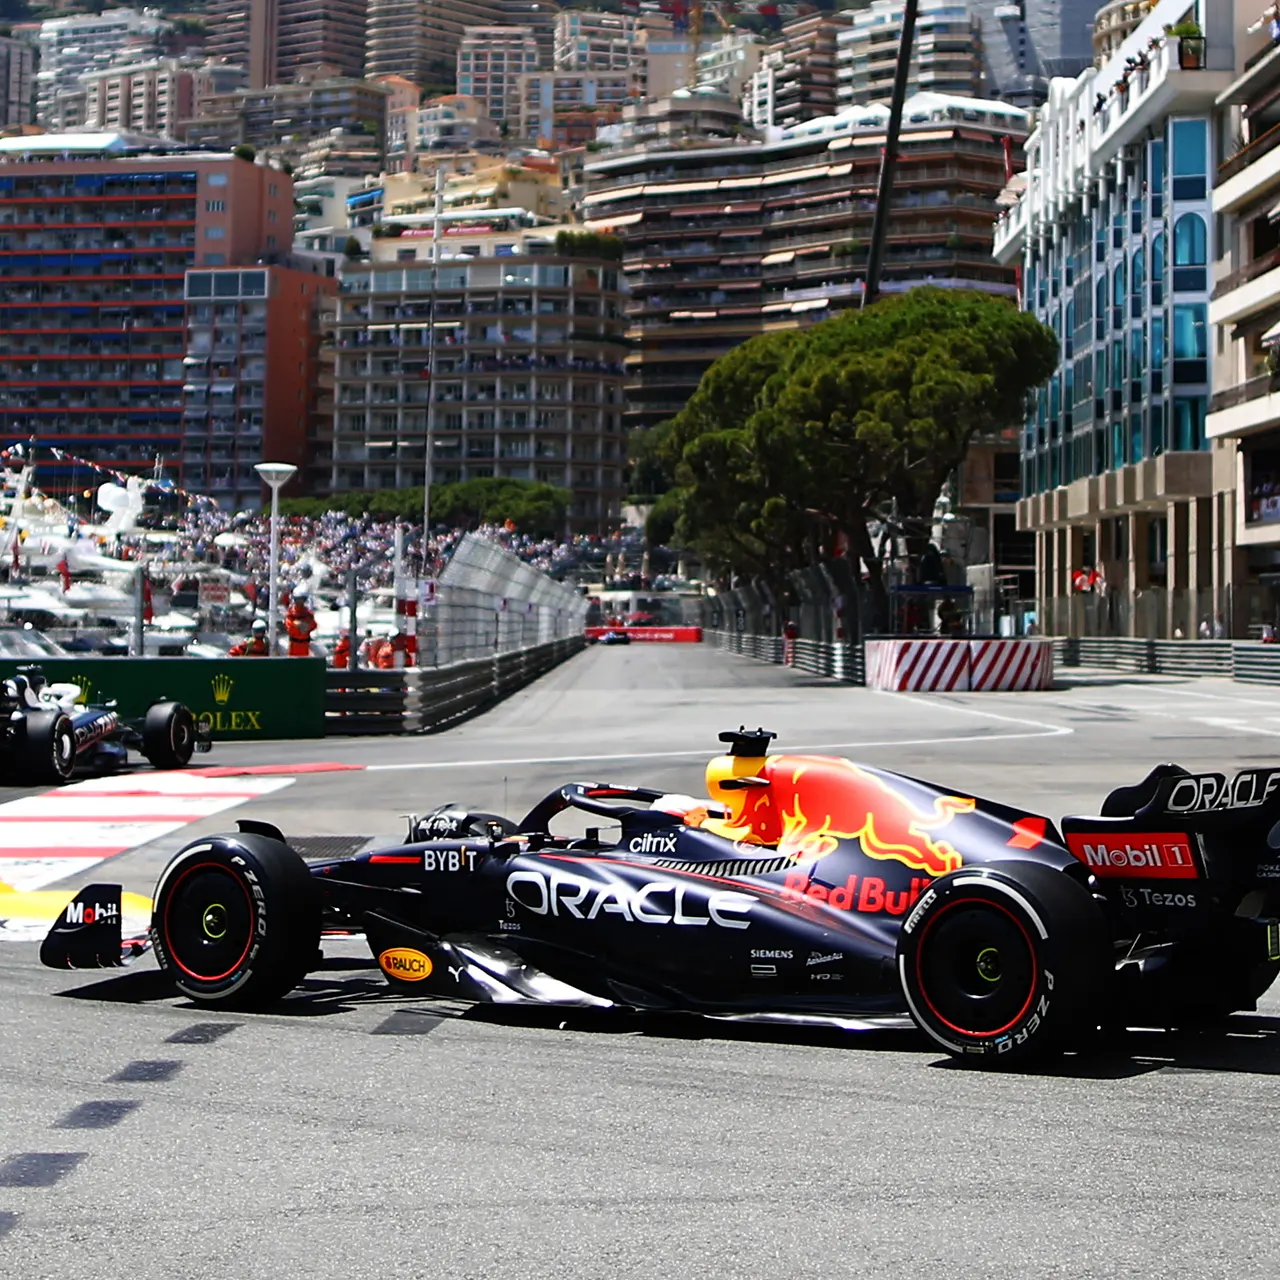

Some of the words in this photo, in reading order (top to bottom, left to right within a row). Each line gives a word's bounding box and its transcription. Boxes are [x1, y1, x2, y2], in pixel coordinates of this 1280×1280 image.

[629, 833, 677, 853] citrix
[424, 845, 477, 872] BYBIT
[1083, 844, 1163, 868] Mobil
[244, 870, 268, 937] ZERO
[506, 871, 759, 930] ORACLE
[780, 873, 857, 912] Red
[1140, 888, 1197, 908] Tezos
[499, 920, 521, 930] Tezos
[392, 957, 426, 973] RAUCH
[750, 949, 794, 959] SIEMENS
[998, 995, 1051, 1054] ZERO
